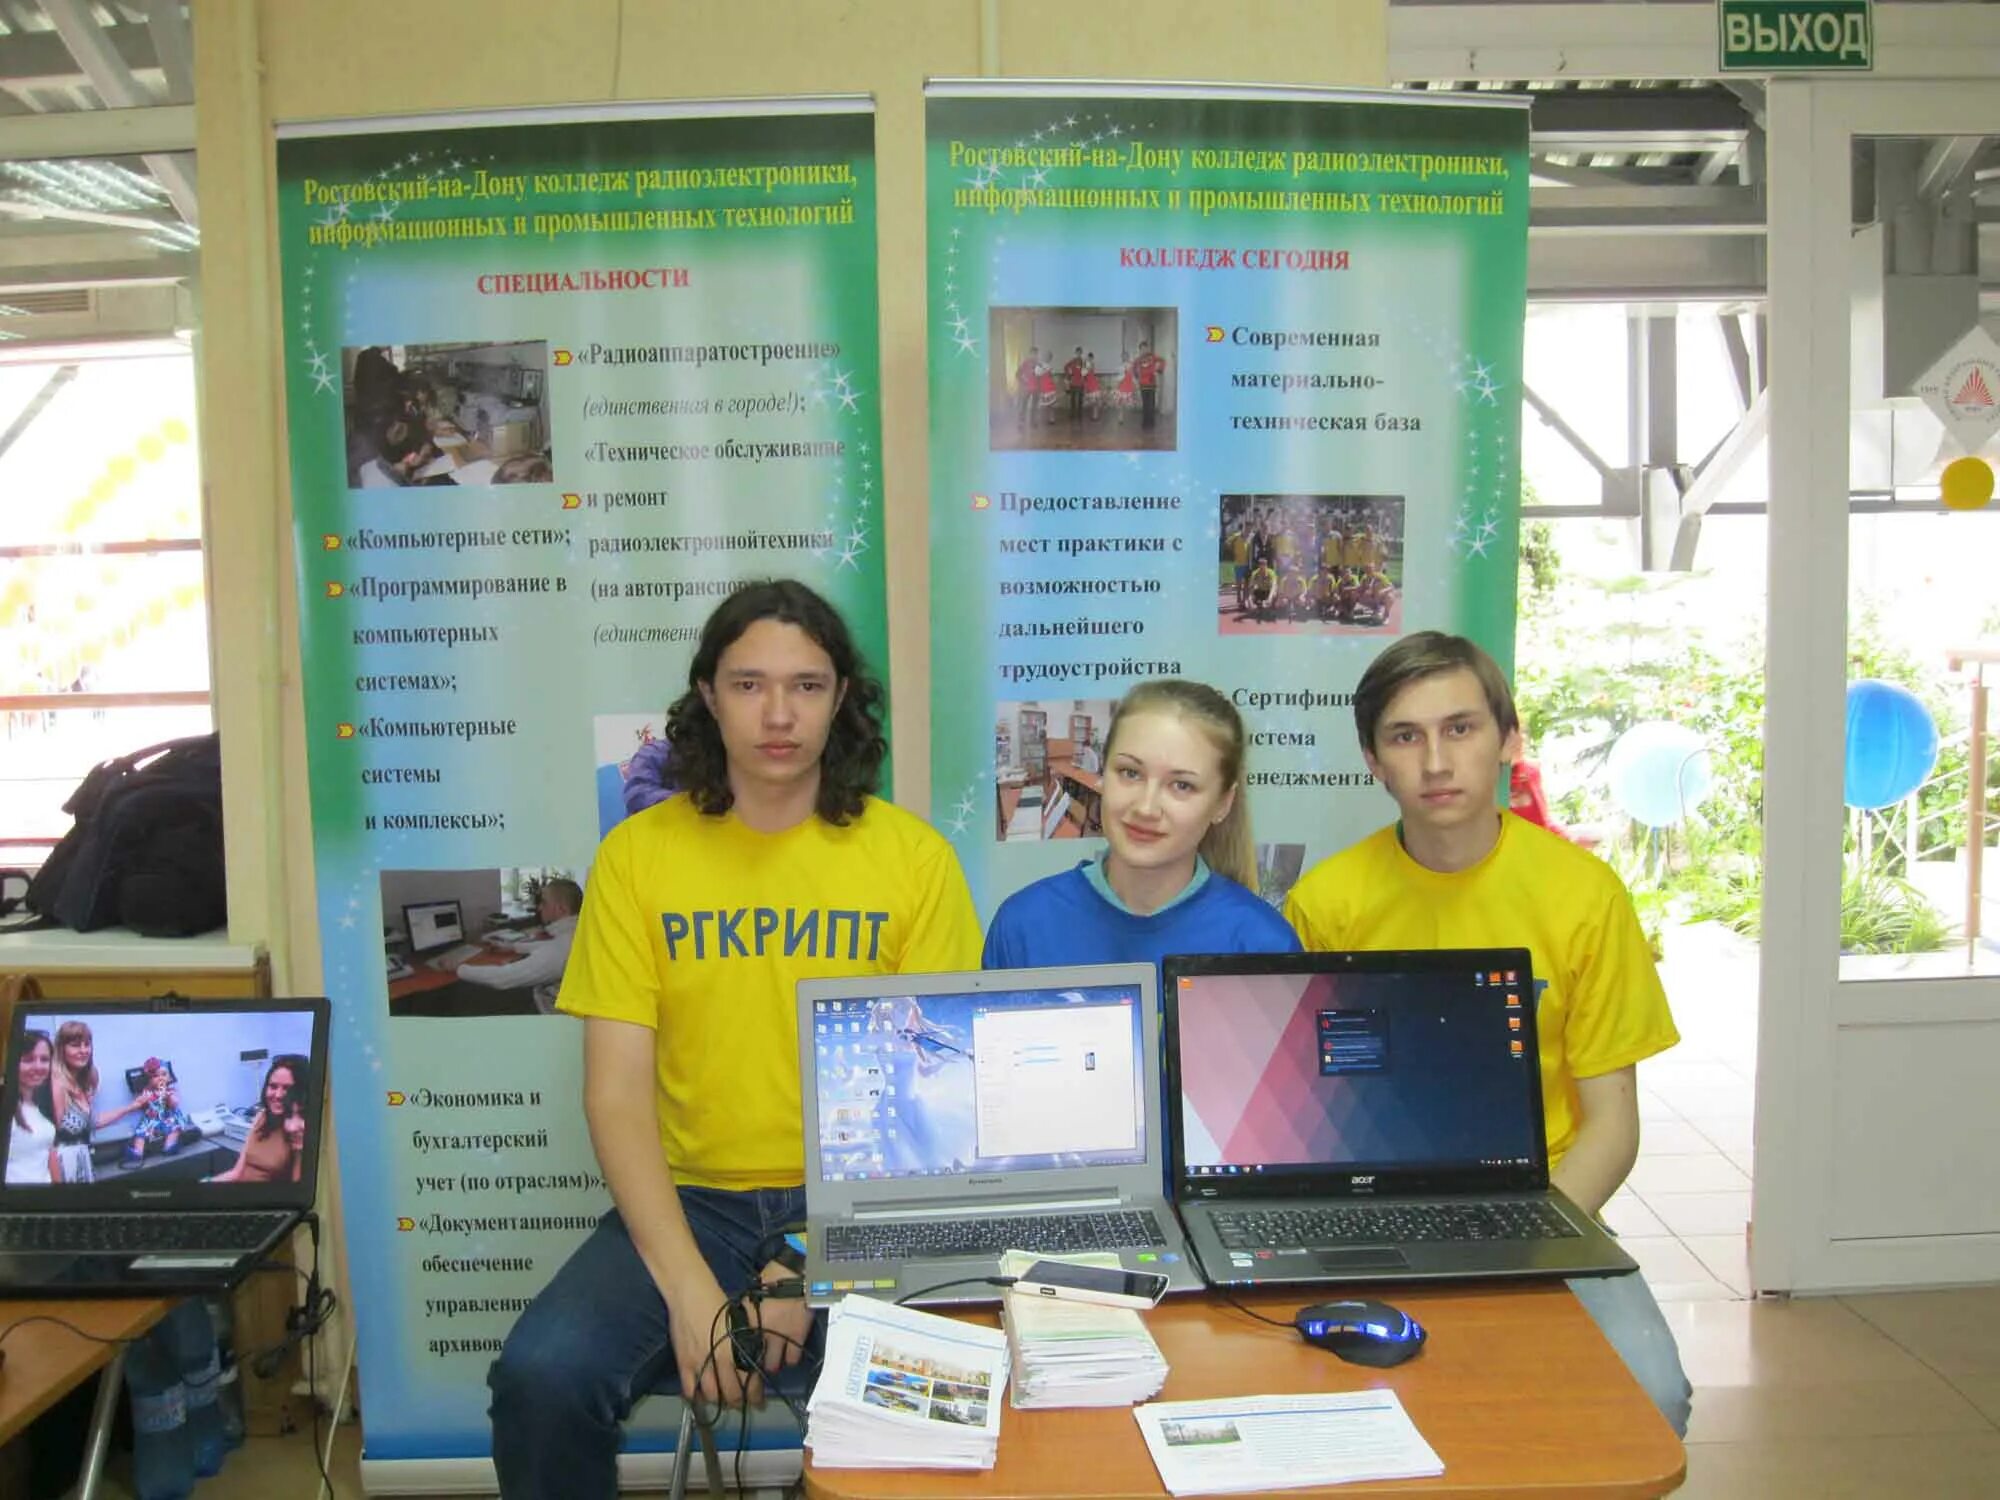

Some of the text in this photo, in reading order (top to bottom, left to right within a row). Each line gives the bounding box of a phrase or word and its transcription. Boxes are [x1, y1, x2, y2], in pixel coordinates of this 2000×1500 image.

[1726, 13, 1867, 60] ВЫХОД
[949, 141, 1510, 183] Ростовский-на-Дону колледж радиоэлектроники,
[304, 161, 858, 208] Ростовский-на-Дону колледж радиоэлектроники,
[953, 187, 1504, 217] информационных и промышленных технологий
[308, 198, 855, 250] информационных и промышленных технологий
[1120, 247, 1350, 272] КОЛЛЕДЖ СЕГОДНЯ
[477, 267, 690, 296] СПЕЦИАЛЬНОСТИ
[1231, 326, 1381, 351] Современная
[578, 342, 841, 368] «Радиоаппаратостроение»
[1231, 372, 1385, 391] материально-
[583, 395, 708, 419] (единственная
[714, 401, 722, 412] в
[1230, 411, 1422, 432] техническая база
[584, 438, 845, 463] «Техническое обслуживание
[587, 491, 668, 513] и ремонт
[999, 493, 1181, 516] Предоставление
[347, 526, 571, 552] «Компьютерные сети»;
[999, 537, 1183, 557] мест практики с
[350, 575, 567, 601] «Программирование в
[591, 578, 618, 601] (на
[999, 578, 1161, 595] возможностью
[353, 624, 499, 647] компьютерных
[593, 624, 704, 647] (единственн
[998, 616, 1144, 640] дальнейшего
[356, 671, 457, 692] системах»;
[999, 658, 1182, 682] трудоустройства
[1232, 688, 1356, 710] Сертифици
[358, 715, 517, 737] «Компьютерные
[1249, 733, 1316, 746] стема
[362, 766, 441, 784] системы
[1246, 771, 1374, 788] енеджмента
[365, 810, 505, 832] и комплексы»;
[661, 908, 889, 961] РГКРИПТ
[410, 1089, 541, 1107] «Экономика и
[412, 1129, 548, 1153] бухгалтерский
[416, 1176, 455, 1194] учет
[460, 1175, 489, 1192] (по
[419, 1214, 599, 1236] «Документационно
[422, 1255, 533, 1273] обеспечение
[428, 1338, 503, 1356] архивов
